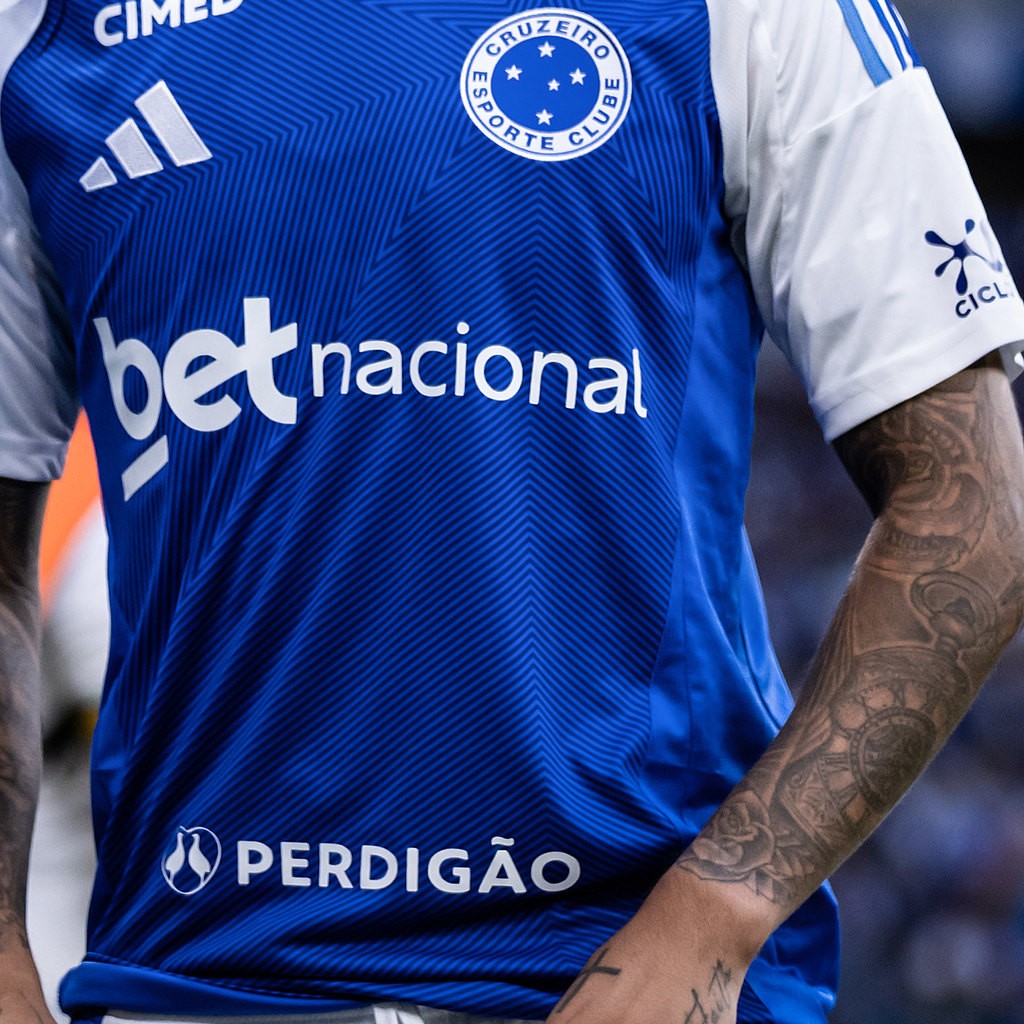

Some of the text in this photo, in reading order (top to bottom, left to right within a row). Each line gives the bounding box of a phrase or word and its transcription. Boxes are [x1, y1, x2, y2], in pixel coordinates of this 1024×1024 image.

[485, 19, 611, 60] CRUZEIRO
[472, 70, 621, 151] ESPORTE CLUBE
[954, 281, 1013, 319] CICL
[236, 835, 582, 895] PERDIGÃO
